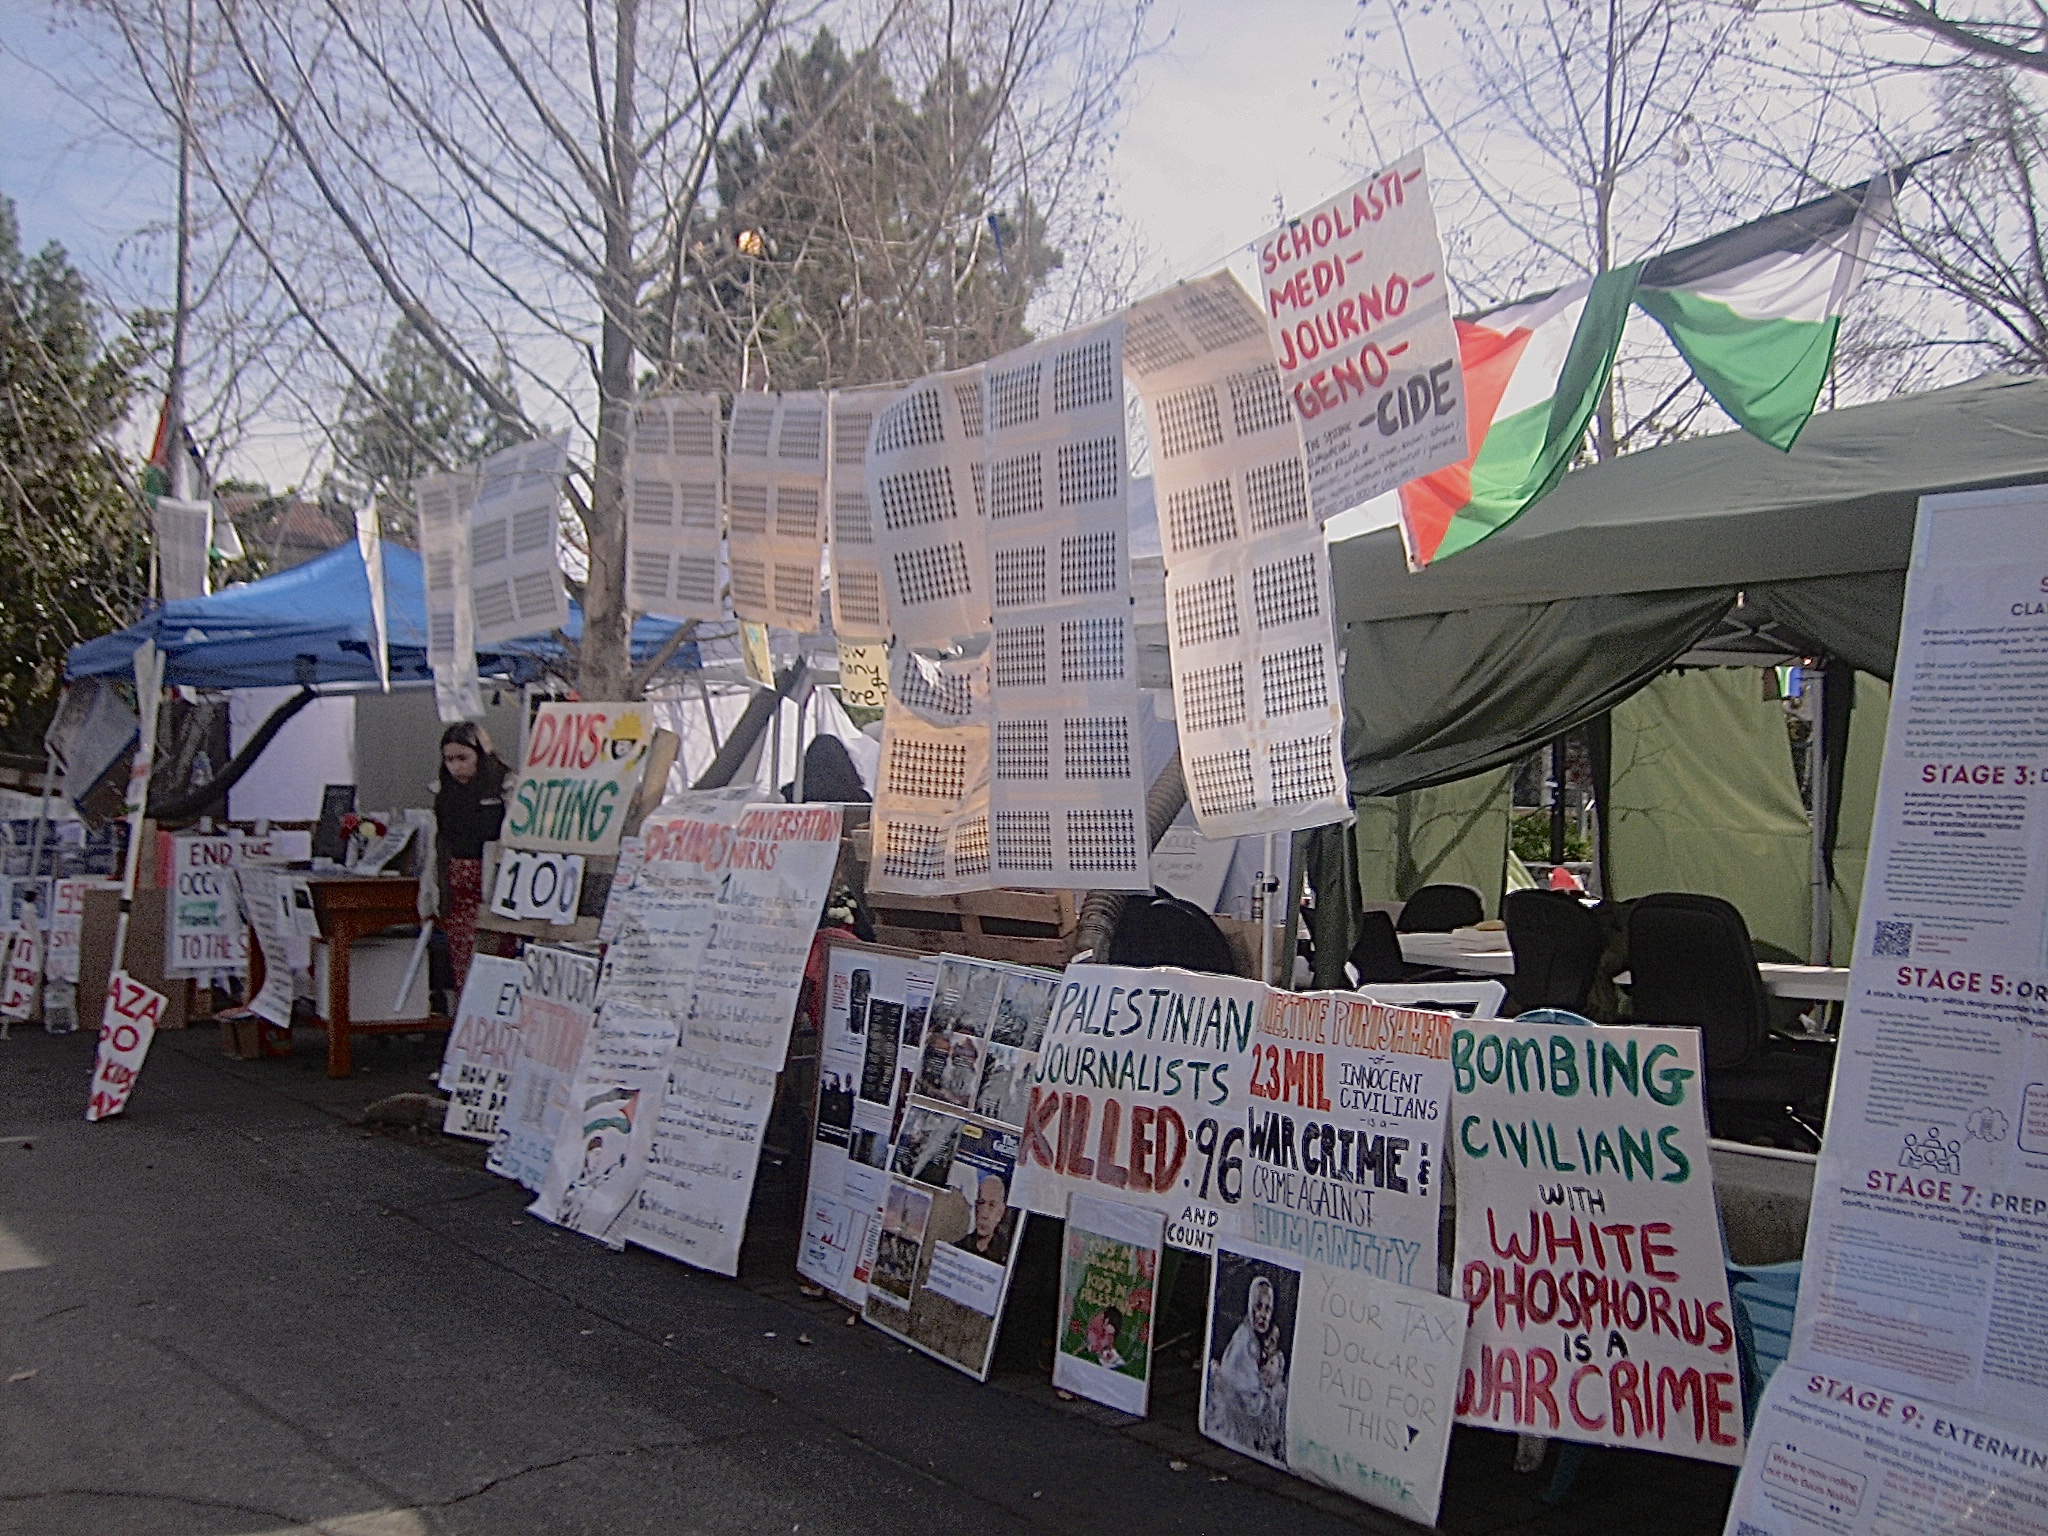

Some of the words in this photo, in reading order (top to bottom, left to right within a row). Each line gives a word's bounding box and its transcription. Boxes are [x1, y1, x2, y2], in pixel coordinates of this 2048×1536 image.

[1262, 167, 1422, 275] SCHOLASTI-
[1269, 250, 1363, 319] MEDI-
[1280, 272, 1436, 371] JOURNO-
[1294, 341, 1409, 419] GENO-
[1358, 358, 1457, 436] -CIDE
[528, 713, 606, 770] DAYS
[1922, 764, 2006, 785] STAGE
[2014, 766, 2036, 785] 3:
[510, 779, 620, 842] SITTING
[190, 842, 233, 867] END
[1897, 966, 1982, 993] STAGE
[1991, 975, 2013, 996] 5:
[1052, 982, 1254, 1053] PALESTINIAN
[1034, 1043, 1229, 1106] JOURNALISTS
[1340, 1063, 1423, 1094] INNOCENT
[1451, 1029, 1695, 1106] BOMBING
[1340, 1088, 1439, 1120] CIVILIANS
[1195, 1117, 1245, 1204] 96
[1249, 1106, 1299, 1171] WAR
[1302, 1121, 1409, 1194] CRIME
[1461, 1114, 1692, 1183] CIVILIANS
[1181, 1206, 1218, 1227] AND
[1252, 1165, 1294, 1207] CRIME
[1299, 1176, 1376, 1227] AGAINST
[1539, 1184, 1606, 1215] WITH
[1866, 1170, 1952, 1203] STAGE
[1961, 1185, 1982, 1208] 7:
[1252, 1202, 1420, 1285] HUMANITY
[1487, 1207, 1678, 1283] WHITE
[1321, 1273, 1383, 1330] YOUR
[1395, 1301, 1456, 1346] TAX
[1462, 1259, 1733, 1354] PHOSPHORUS
[1323, 1324, 1435, 1388] DOLLARS
[1564, 1332, 1592, 1363] IS
[1606, 1330, 1629, 1357] A
[1319, 1361, 1374, 1402] PAID
[1386, 1385, 1437, 1426] FOR
[1454, 1344, 1561, 1429] WAR
[1569, 1358, 1738, 1447] CRIME
[1807, 1375, 1894, 1419] STAGE
[1901, 1405, 1924, 1430] 9:
